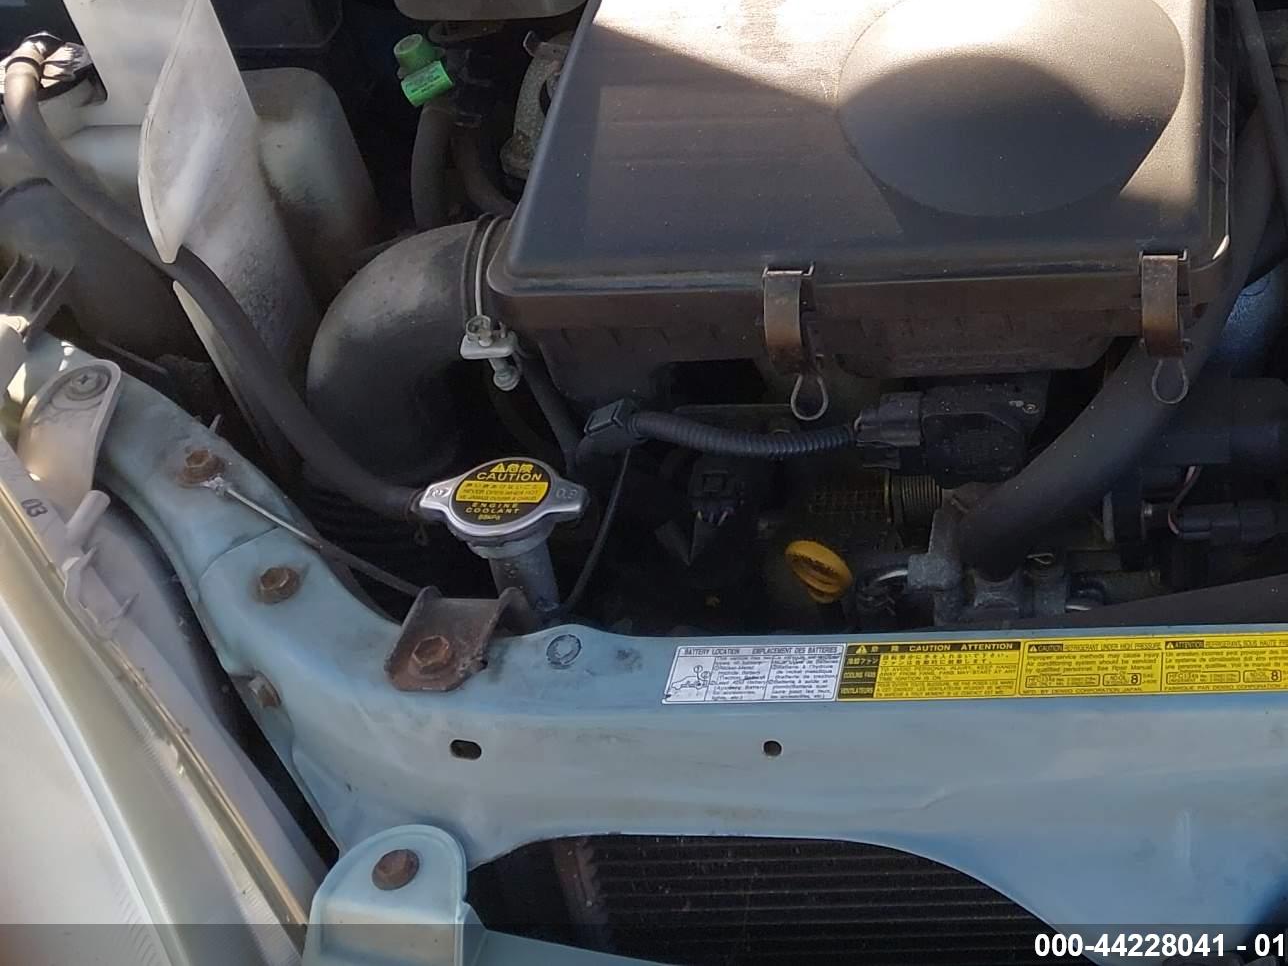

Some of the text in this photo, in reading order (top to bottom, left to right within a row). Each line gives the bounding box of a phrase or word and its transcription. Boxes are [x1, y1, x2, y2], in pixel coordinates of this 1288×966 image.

[476, 472, 542, 481] CAUTION
[909, 644, 951, 652] CAUTION
[1130, 674, 1139, 684] 8
[1271, 670, 1279, 681] 8
